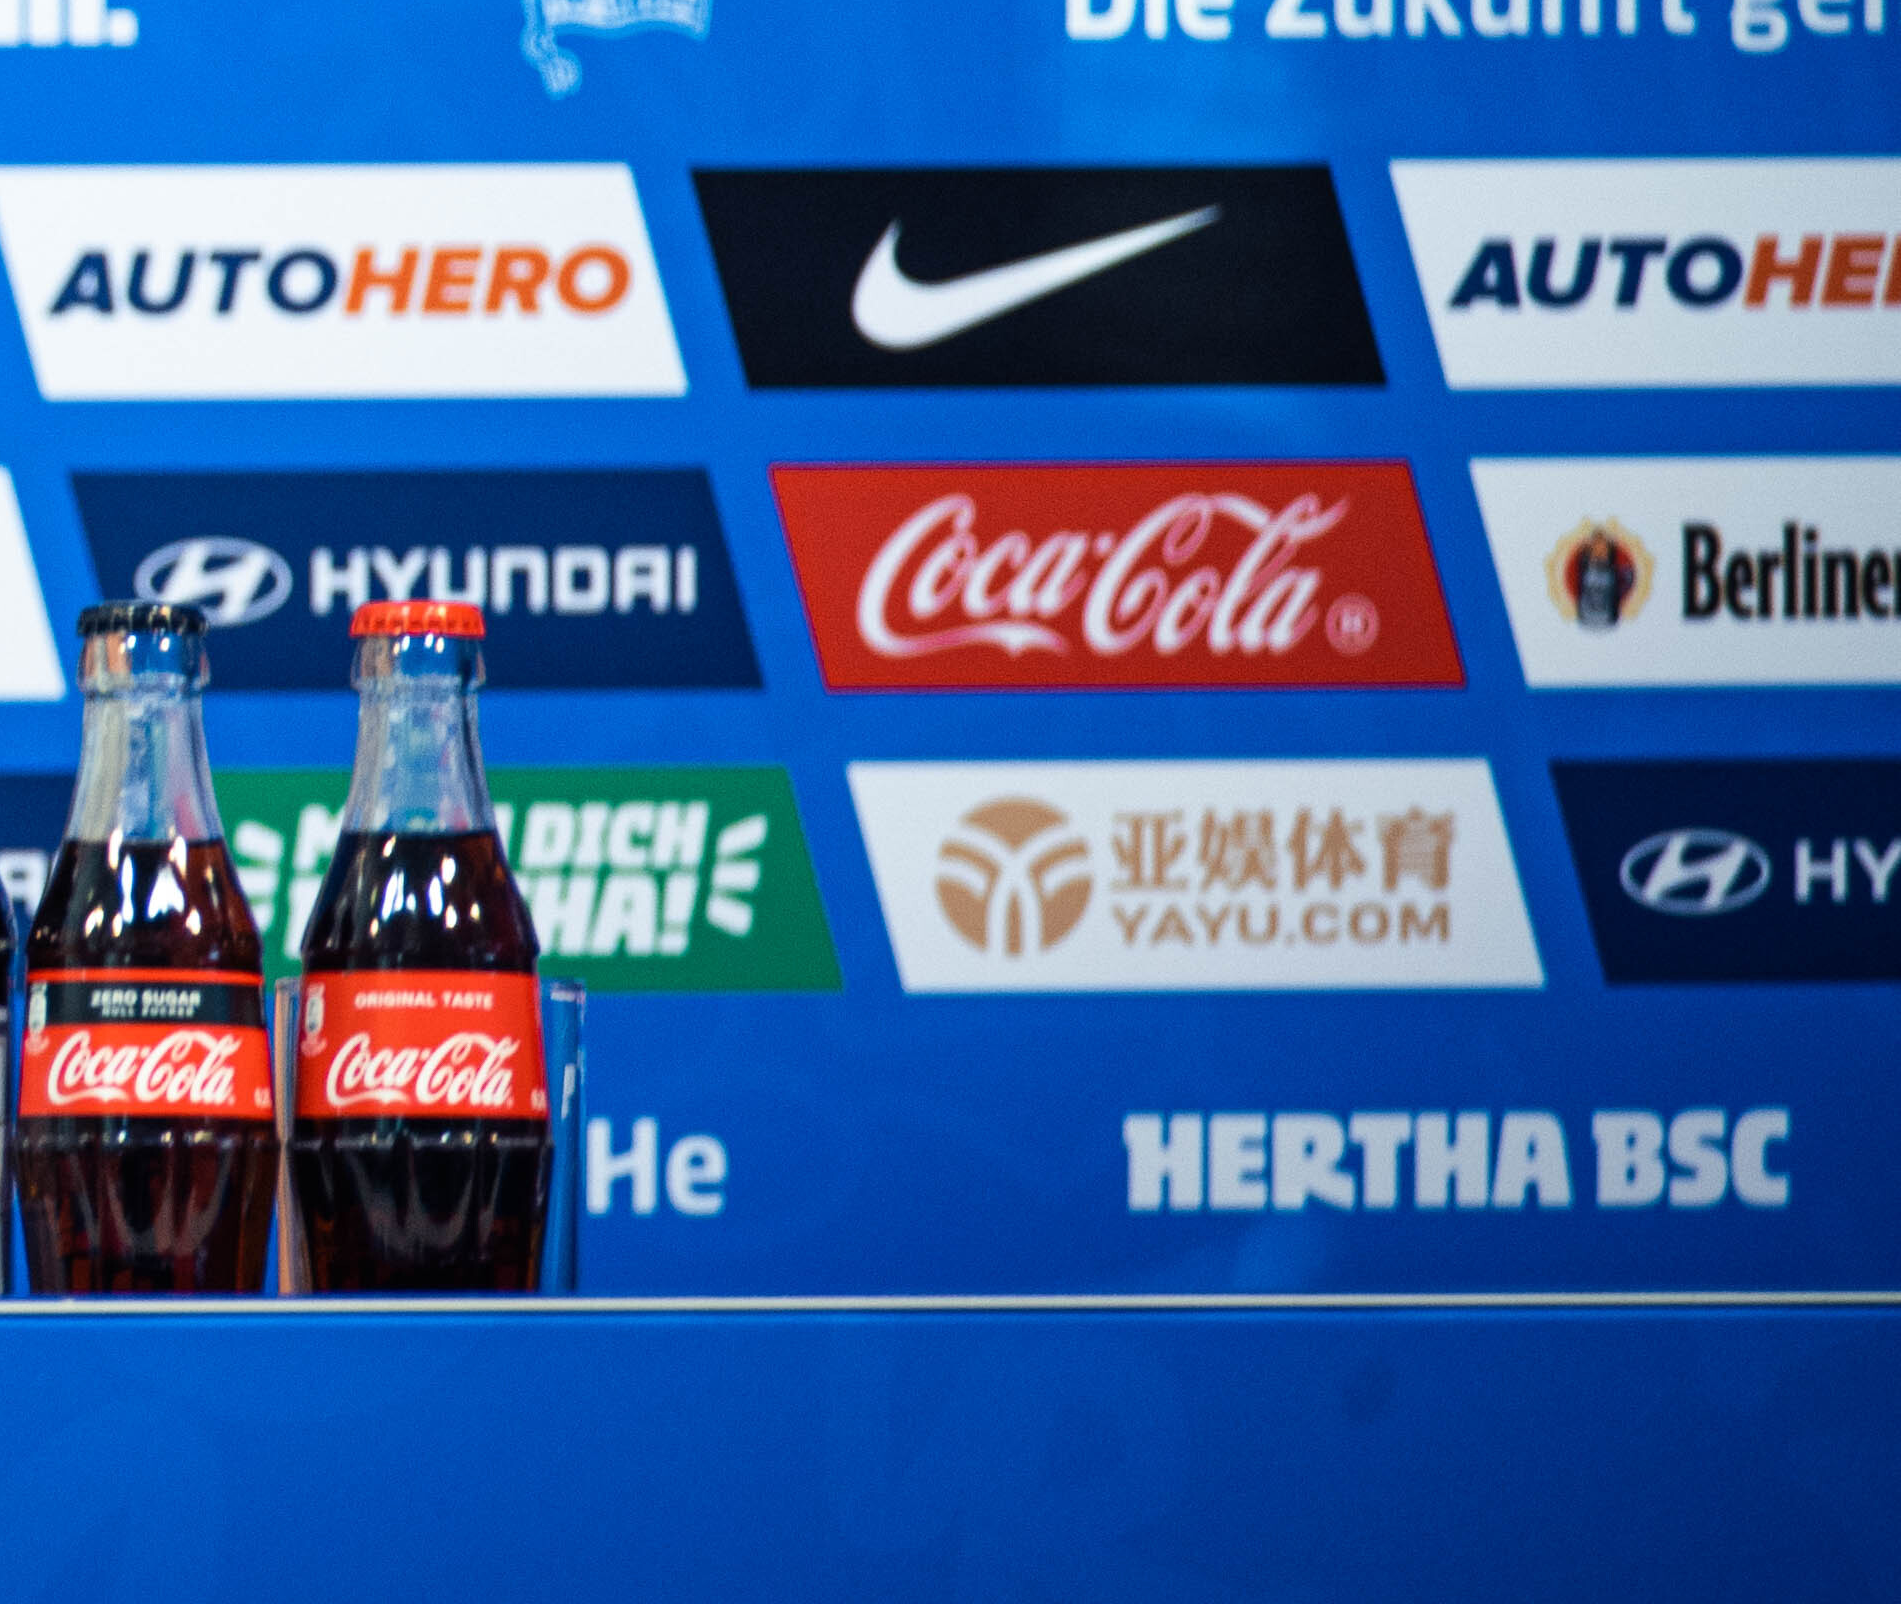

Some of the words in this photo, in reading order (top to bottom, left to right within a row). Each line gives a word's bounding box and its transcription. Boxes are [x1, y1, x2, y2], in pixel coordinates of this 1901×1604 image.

[49, 246, 629, 317] AUTOHERO
[1448, 234, 1901, 309] AUTOHE
[309, 545, 697, 614] HYUNDAI
[1680, 520, 1901, 625] Berline
[1112, 903, 1452, 946] YAYU.COM
[90, 989, 138, 1008] ZERO
[141, 989, 201, 1008] SUGAR
[354, 991, 437, 1009] ORIGINAL
[442, 991, 494, 1010] TASTE
[48, 1030, 242, 1106] Coca-Cola
[325, 1031, 521, 1107] Coca-Cola
[1123, 1110, 1572, 1212] HERTHA
[1591, 1108, 1791, 1209] BSC
